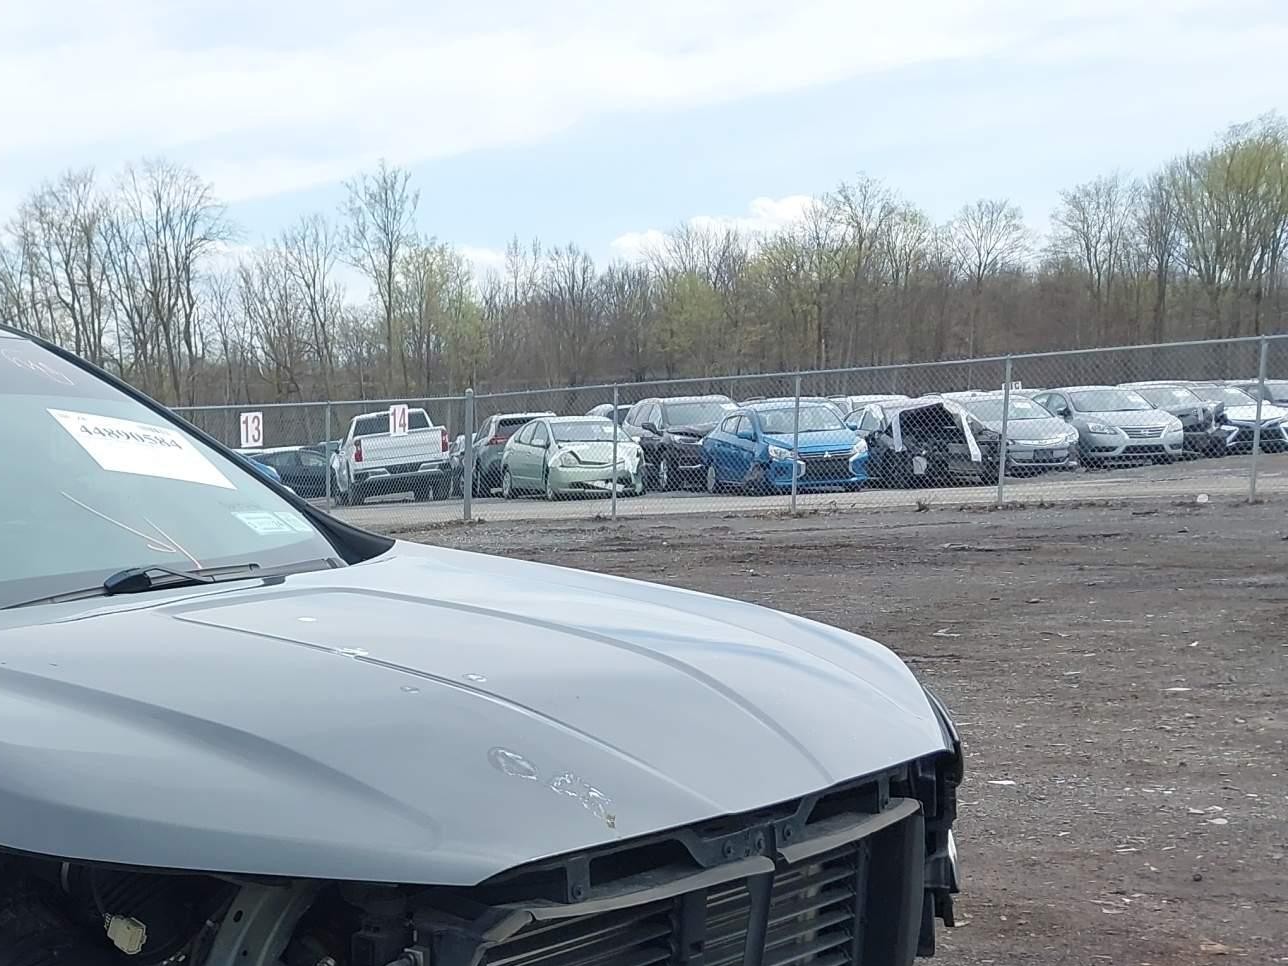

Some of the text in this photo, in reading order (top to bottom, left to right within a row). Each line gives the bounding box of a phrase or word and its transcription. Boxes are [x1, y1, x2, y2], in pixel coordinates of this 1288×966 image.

[242, 415, 261, 443] 13
[391, 406, 407, 433] 14
[79, 424, 183, 450] 44890584
